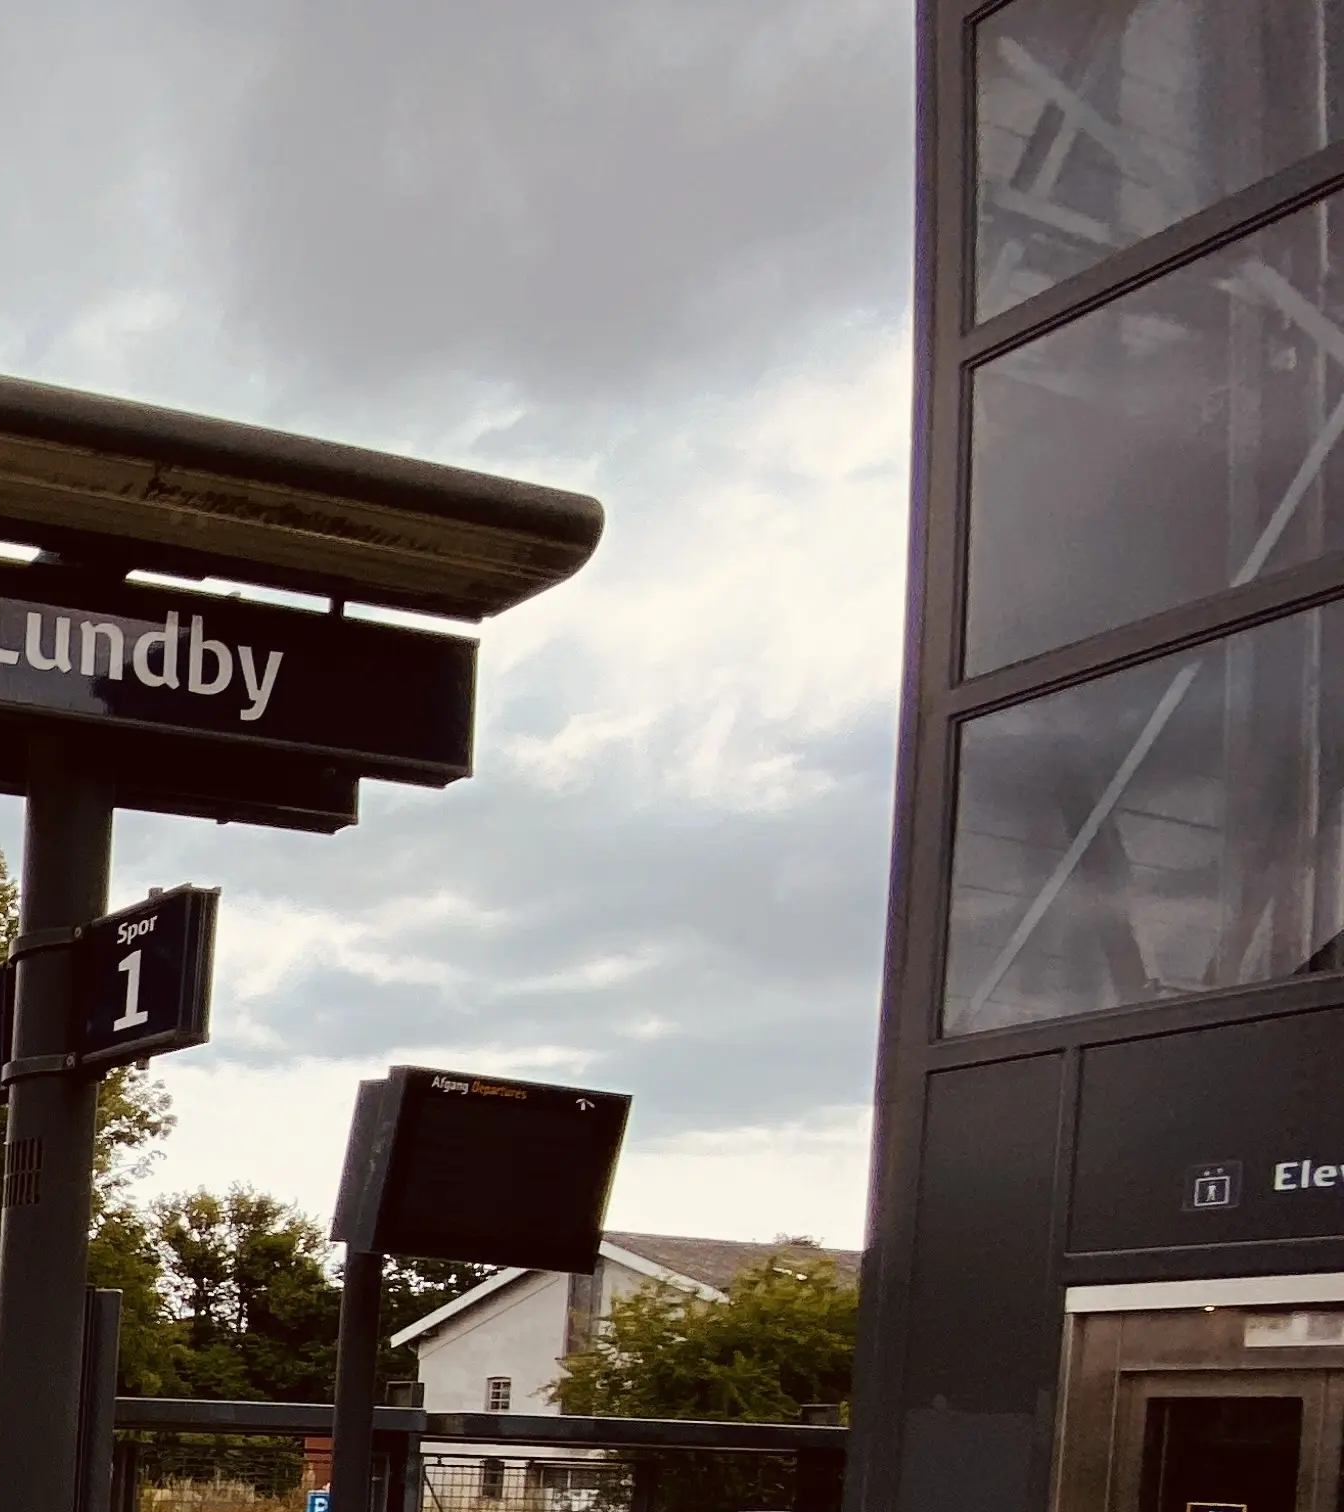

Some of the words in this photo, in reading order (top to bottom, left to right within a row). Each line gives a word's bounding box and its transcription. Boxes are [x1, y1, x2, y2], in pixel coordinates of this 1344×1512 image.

[116, 915, 158, 945] Spor
[113, 949, 148, 1032] 1
[431, 1075, 469, 1095] Afgang
[471, 1080, 527, 1100] Departures
[1274, 1159, 1344, 1190] Ele
